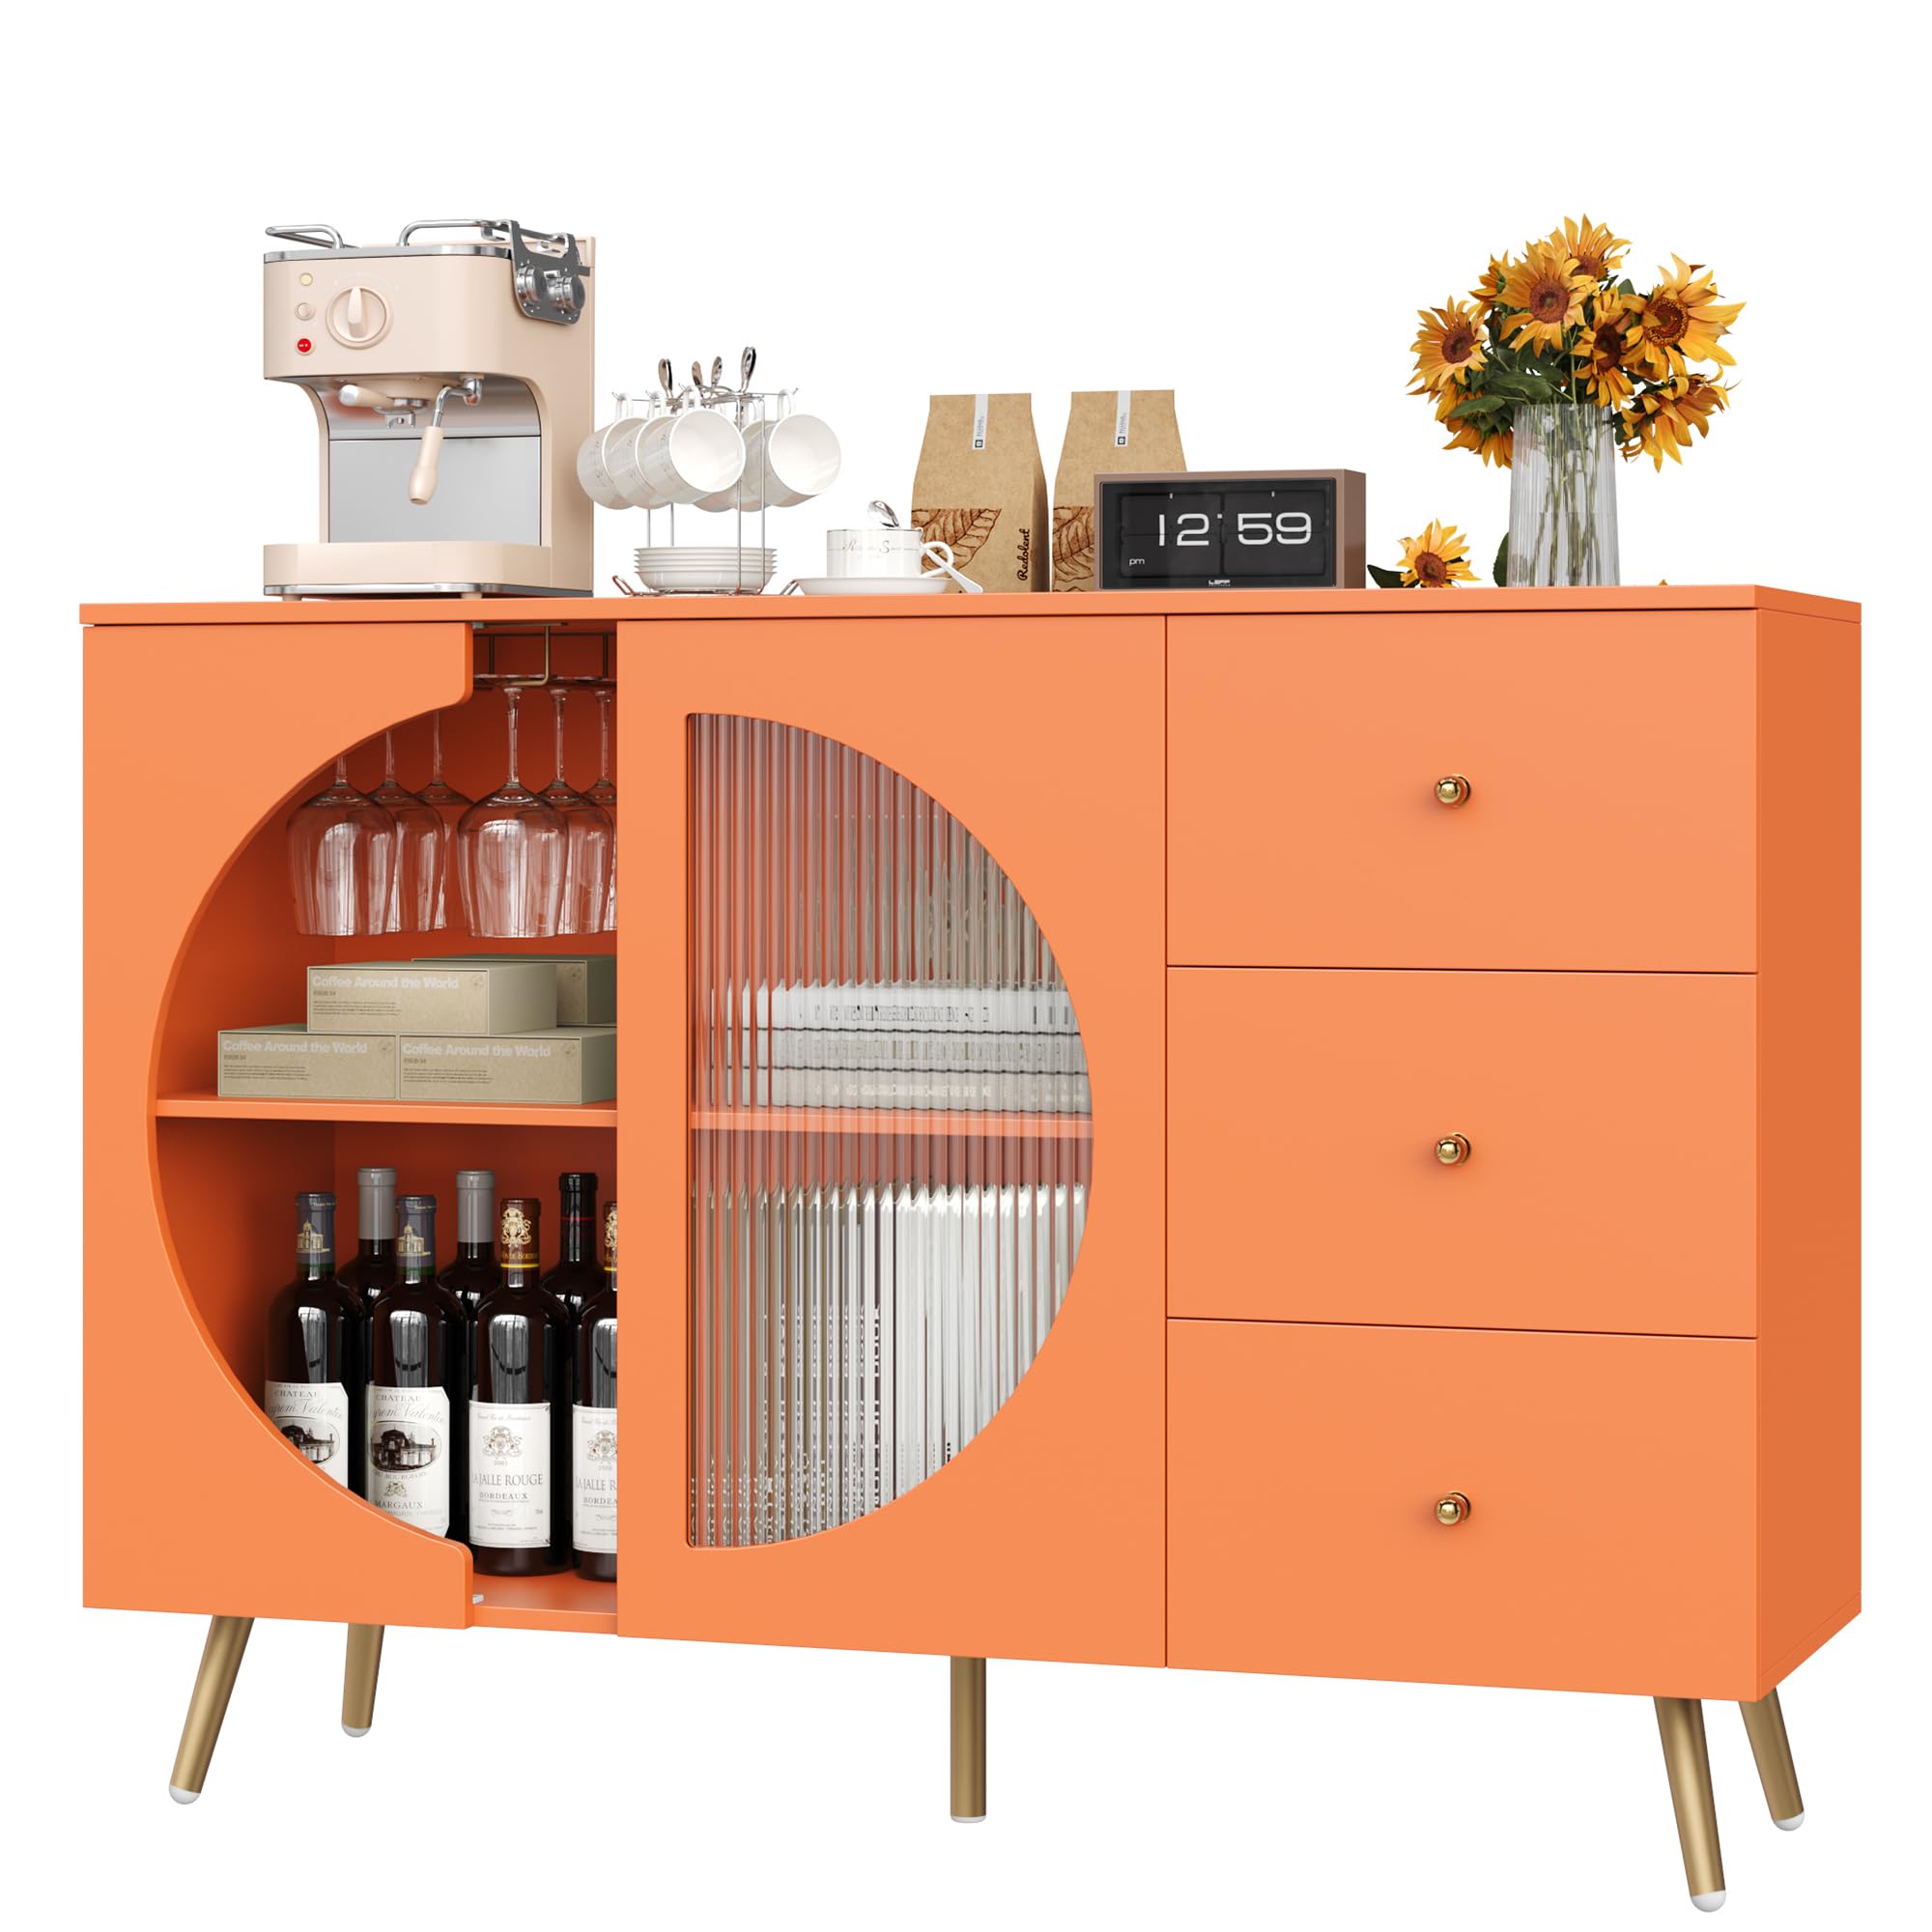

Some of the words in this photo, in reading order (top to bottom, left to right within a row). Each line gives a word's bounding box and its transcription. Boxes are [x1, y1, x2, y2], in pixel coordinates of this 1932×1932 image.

[1017, 528, 1032, 582] Redolent
[1129, 557, 1146, 567] pm
[312, 976, 353, 988] Coffee
[355, 976, 399, 989] Around
[401, 977, 421, 989] the
[423, 978, 460, 990] World
[222, 1040, 263, 1052] Coffee
[265, 1041, 309, 1053] Around
[309, 1041, 330, 1053] the
[332, 1042, 369, 1054] World
[402, 1043, 442, 1055] Coffee
[444, 1044, 490, 1057] Around
[492, 1044, 513, 1057] the
[515, 1045, 552, 1058] World
[479, 1473, 502, 1487] JALLE
[505, 1473, 544, 1487] ROUGE
[583, 1477, 607, 1492] JALLE
[479, 1491, 528, 1500] BORDEAUX
[583, 1496, 616, 1505] BORDEA
[375, 1499, 423, 1509] MARGAUX
